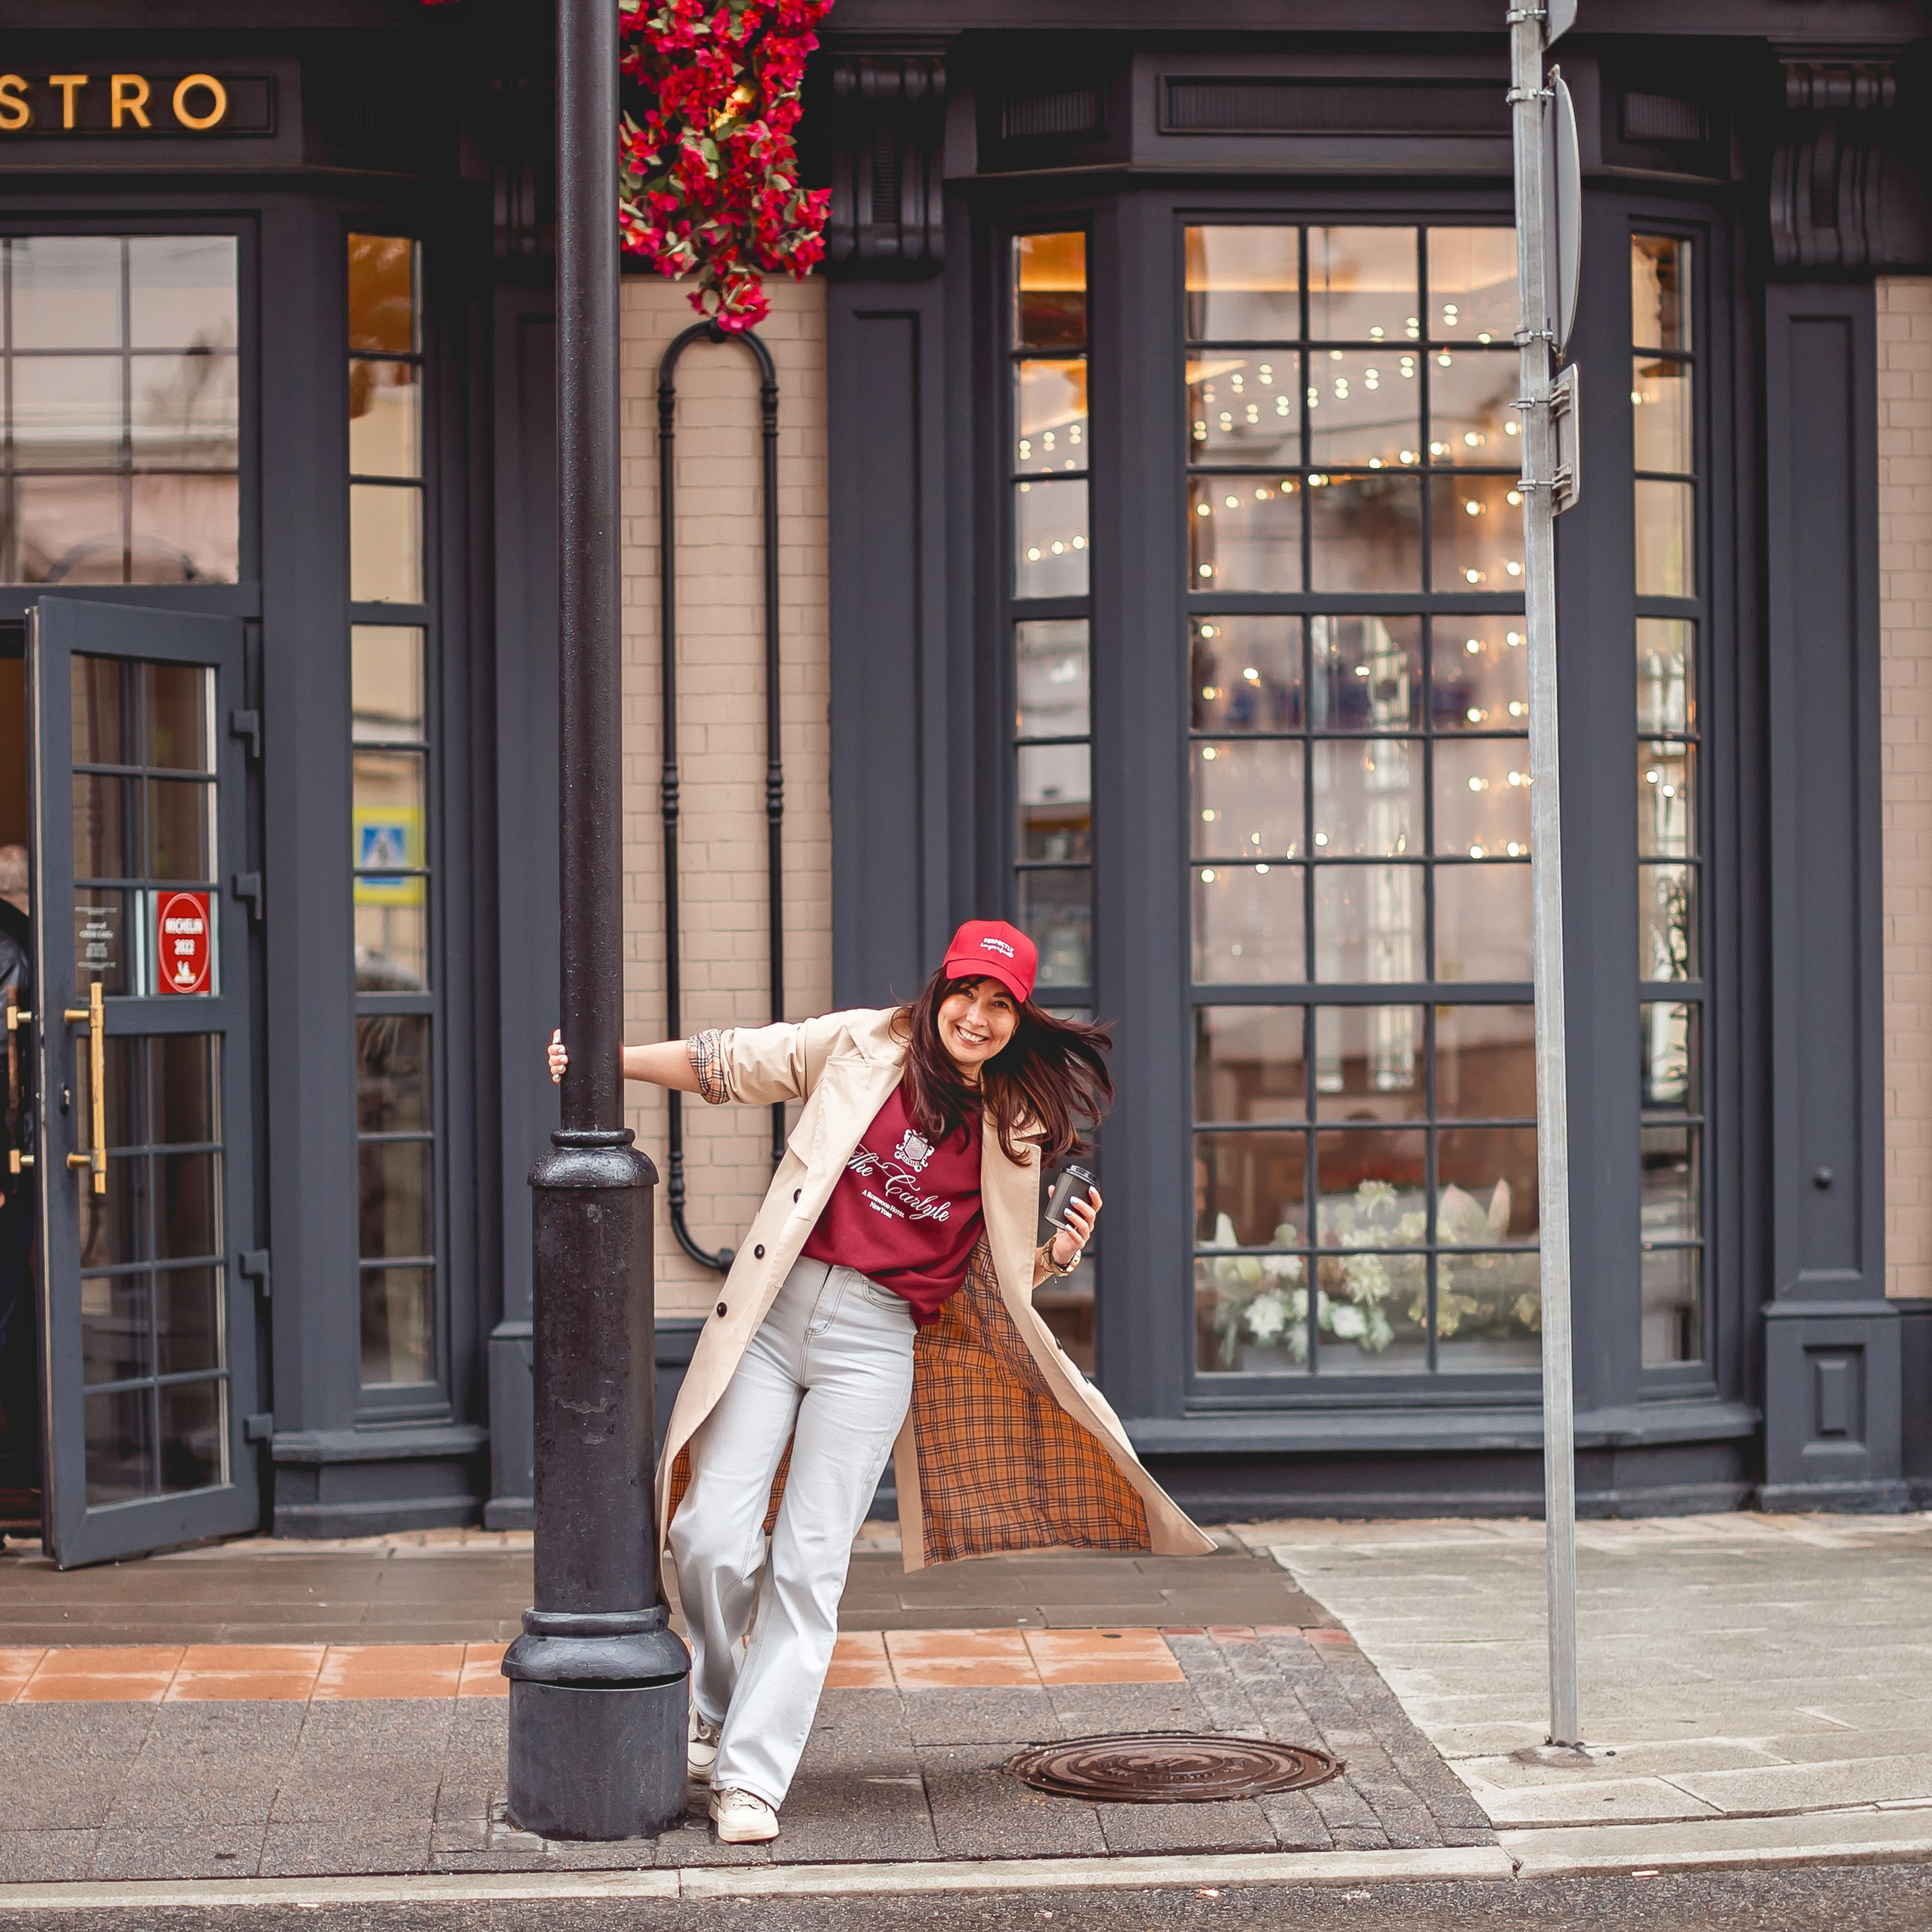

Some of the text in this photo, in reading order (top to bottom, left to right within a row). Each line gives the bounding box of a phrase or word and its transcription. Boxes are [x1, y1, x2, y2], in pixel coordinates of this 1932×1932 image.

[165, 918, 204, 934] MICHELIN
[983, 937, 1014, 952] PERFECTLY
[883, 1162, 951, 1222] Carlyle
